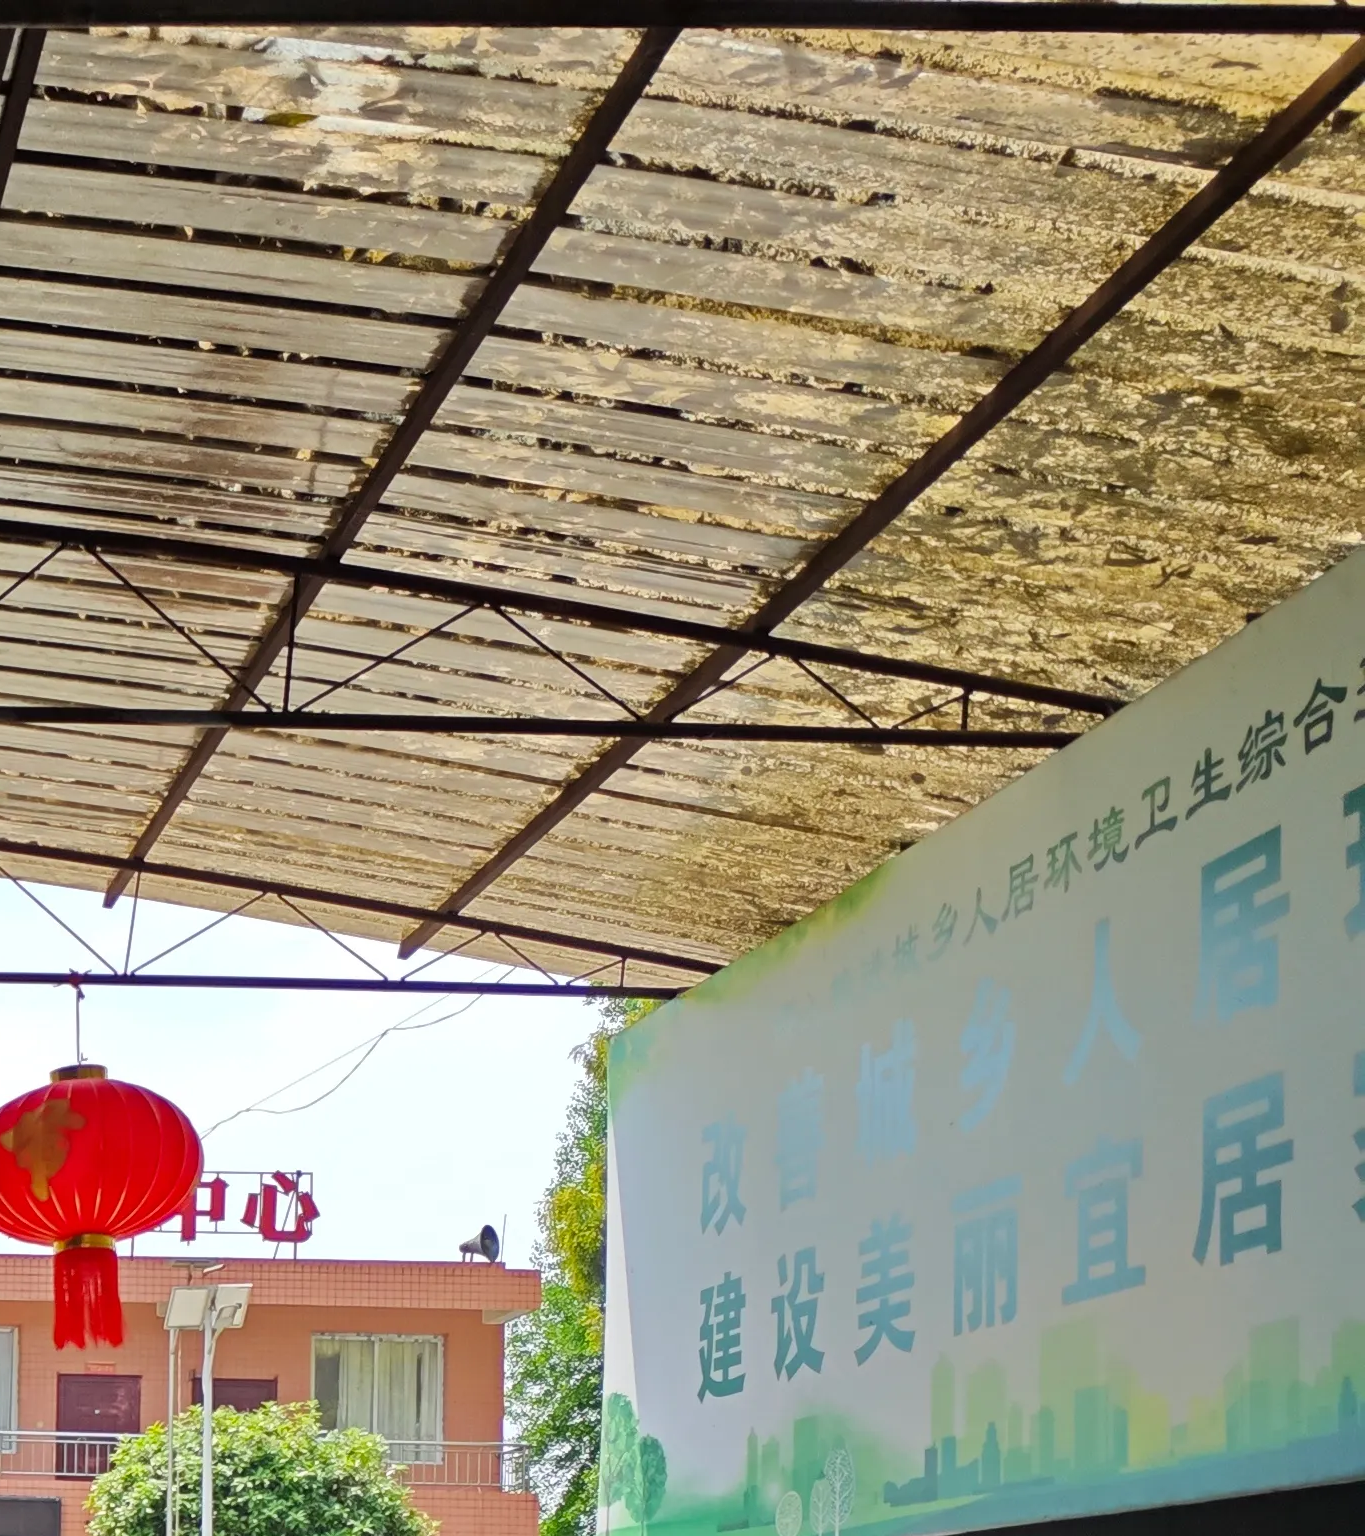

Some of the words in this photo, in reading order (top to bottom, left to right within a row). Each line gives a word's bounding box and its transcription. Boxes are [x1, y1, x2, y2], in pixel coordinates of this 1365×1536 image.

[697, 1050, 1365, 1404] 建设美丽宜居
